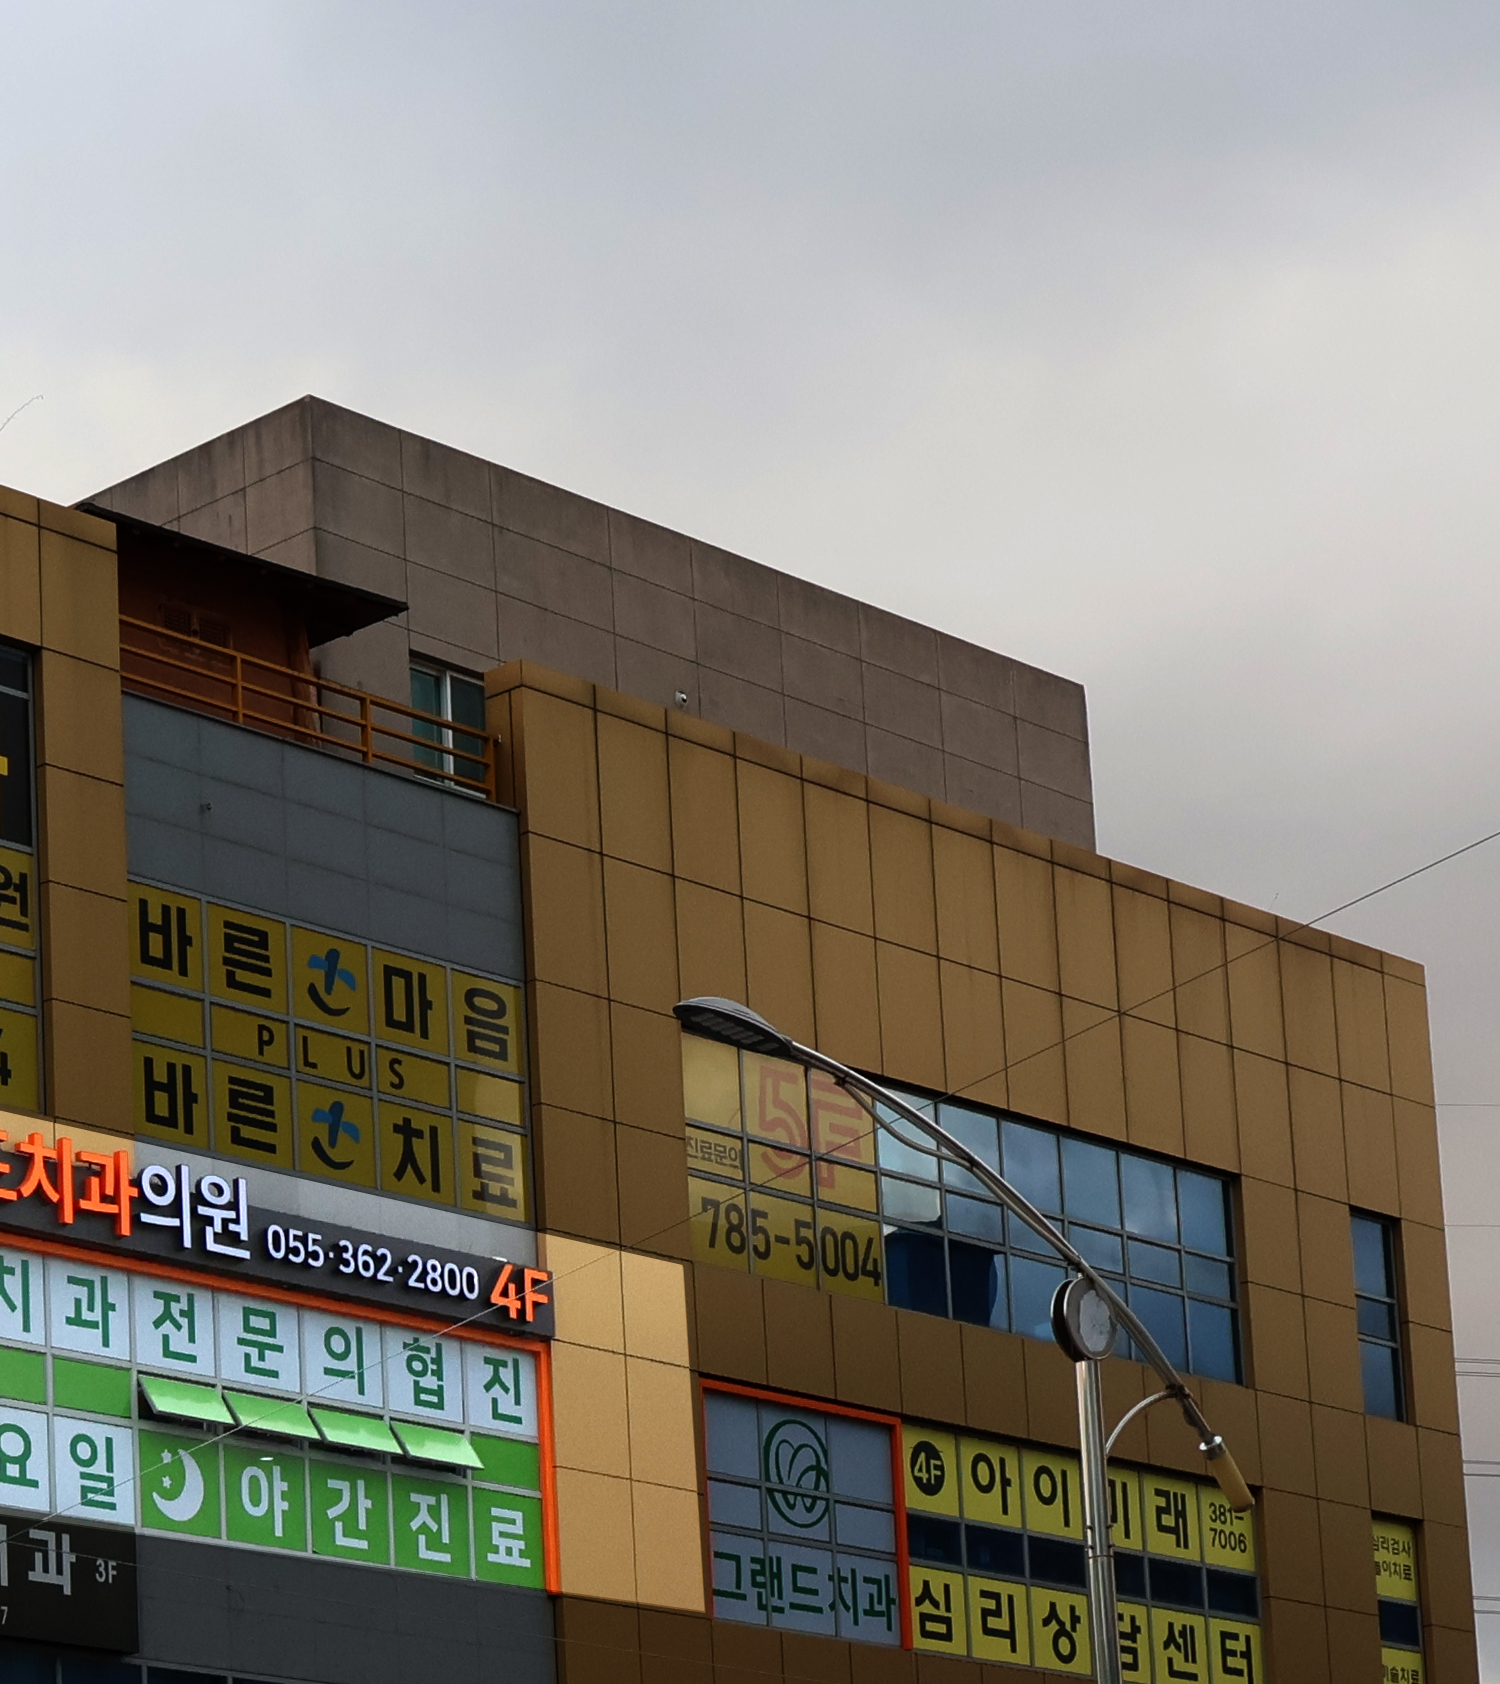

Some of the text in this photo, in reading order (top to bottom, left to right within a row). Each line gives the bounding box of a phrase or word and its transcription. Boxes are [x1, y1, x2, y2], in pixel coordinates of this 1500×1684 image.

[256, 1021, 404, 1090] PLUS
[759, 1065, 863, 1189] 5F
[702, 1196, 881, 1287] 785-5004
[491, 1263, 548, 1322] 4F
[911, 1451, 943, 1486] 4F
[240, 1462, 531, 1569] 야간진료
[1210, 1528, 1247, 1557] 7006
[95, 1560, 118, 1584] 3F
[712, 1547, 897, 1632] 그랜드치과
